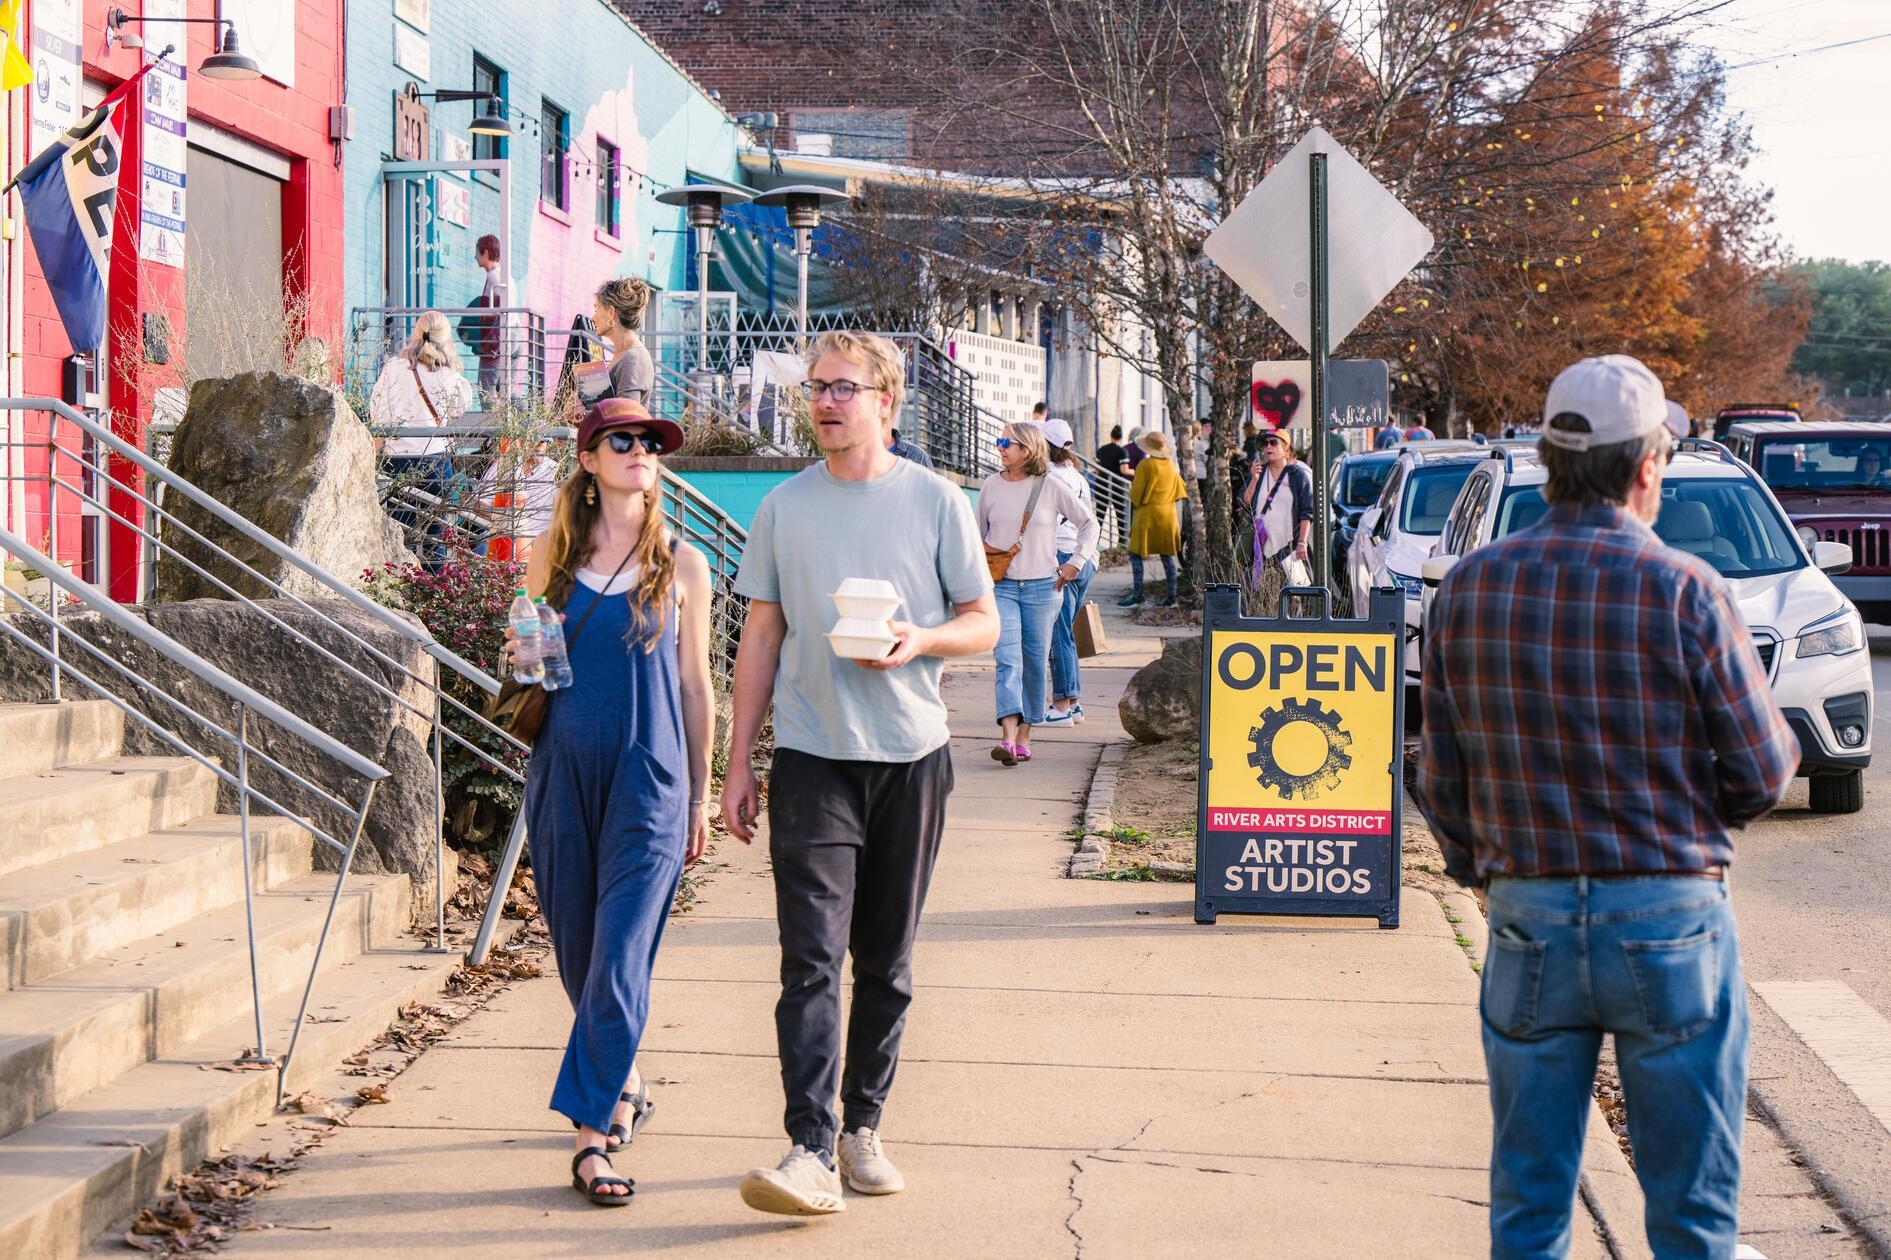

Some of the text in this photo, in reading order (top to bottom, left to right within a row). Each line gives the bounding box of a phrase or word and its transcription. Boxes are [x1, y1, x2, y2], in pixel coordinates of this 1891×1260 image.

[66, 105, 119, 261] OPE
[1860, 522, 1881, 530] Jeep
[1218, 642, 1386, 692] OPEN
[1213, 812, 1386, 830] RIVER ARTS DISTRICT
[1239, 838, 1357, 866] ARTIST
[1224, 865, 1371, 895] STUDIOS
